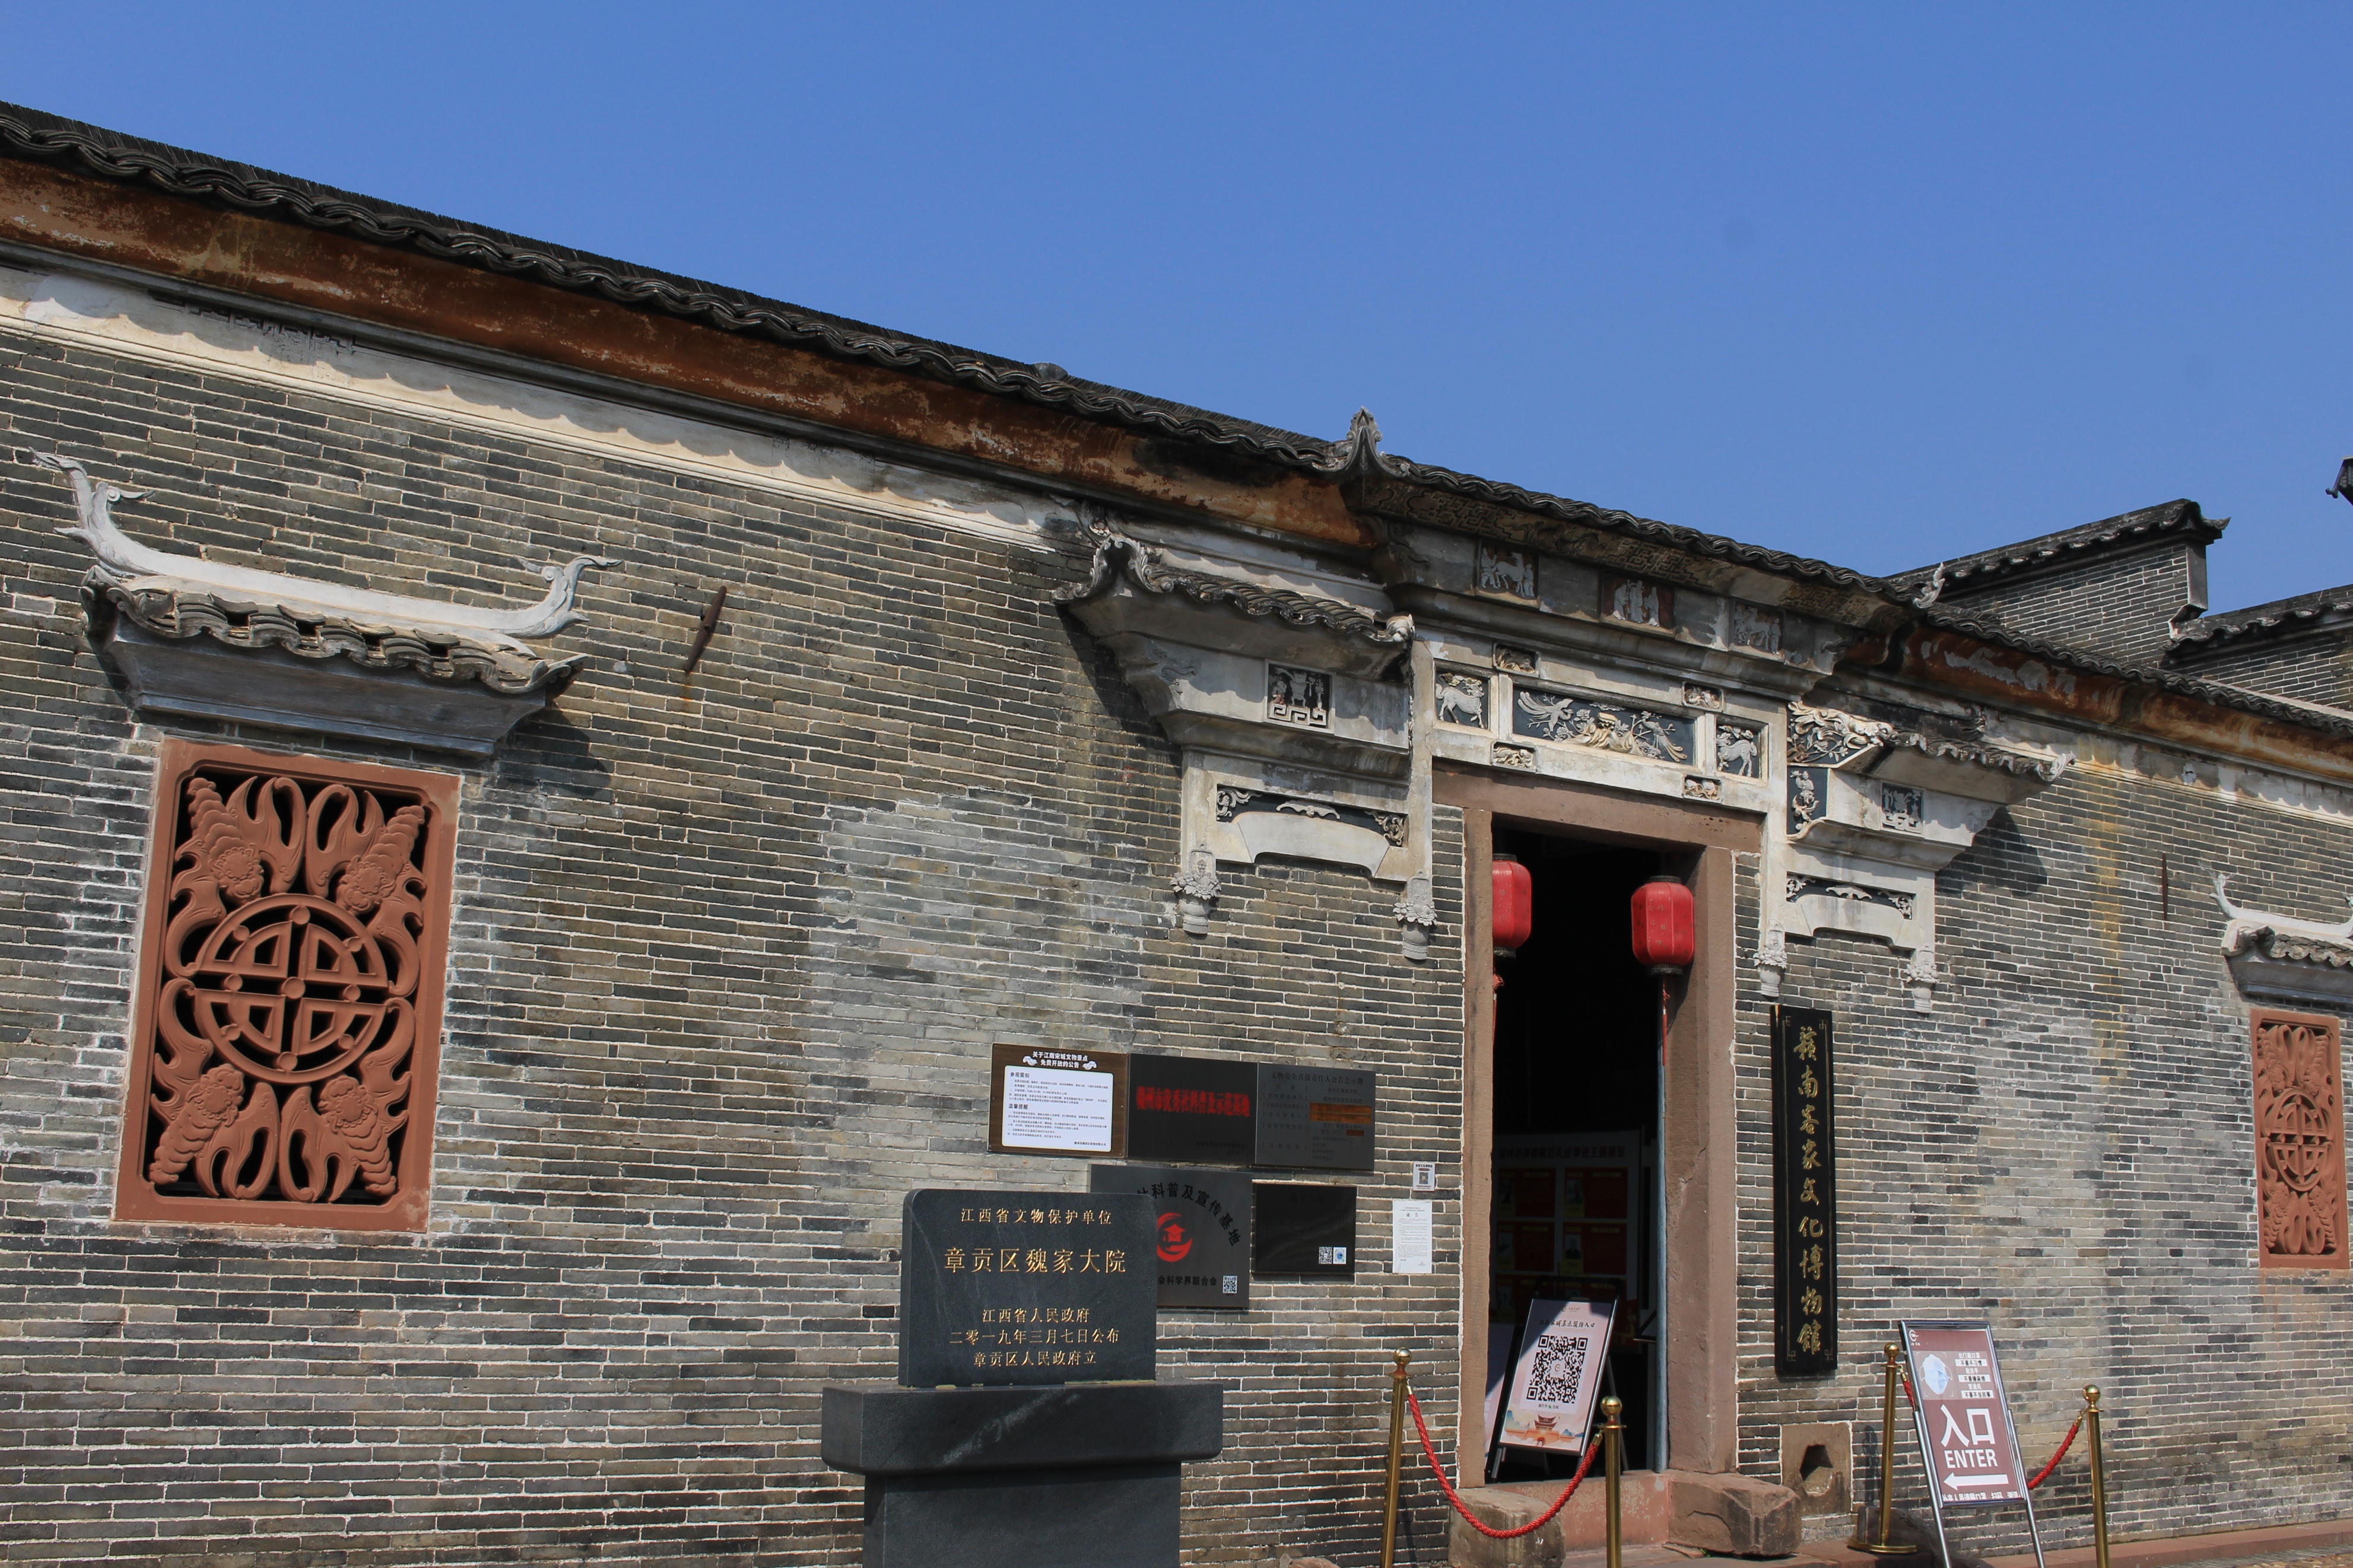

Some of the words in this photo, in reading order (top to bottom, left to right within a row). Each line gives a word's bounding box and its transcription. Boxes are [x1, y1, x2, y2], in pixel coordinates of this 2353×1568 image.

[1032, 1051, 1088, 1062] 关于江南宋城文物景点
[1040, 1059, 1080, 1068] 免费开放的公告
[1271, 1071, 1364, 1085] 文物安全直接责任人公告公示牌
[961, 1208, 1112, 1224] 江西省文物保护单位
[944, 1246, 1127, 1274] 章贡区魏家大院
[1158, 1275, 1217, 1286] 会科学界联合会
[983, 1308, 1090, 1324] 江西省人民政府
[950, 1328, 1120, 1346] 二零一九年三月七日公布
[973, 1350, 1097, 1367] 章贡区人民政府立
[1940, 1404, 1996, 1447] 入口
[1944, 1448, 1998, 1468] ENTER
